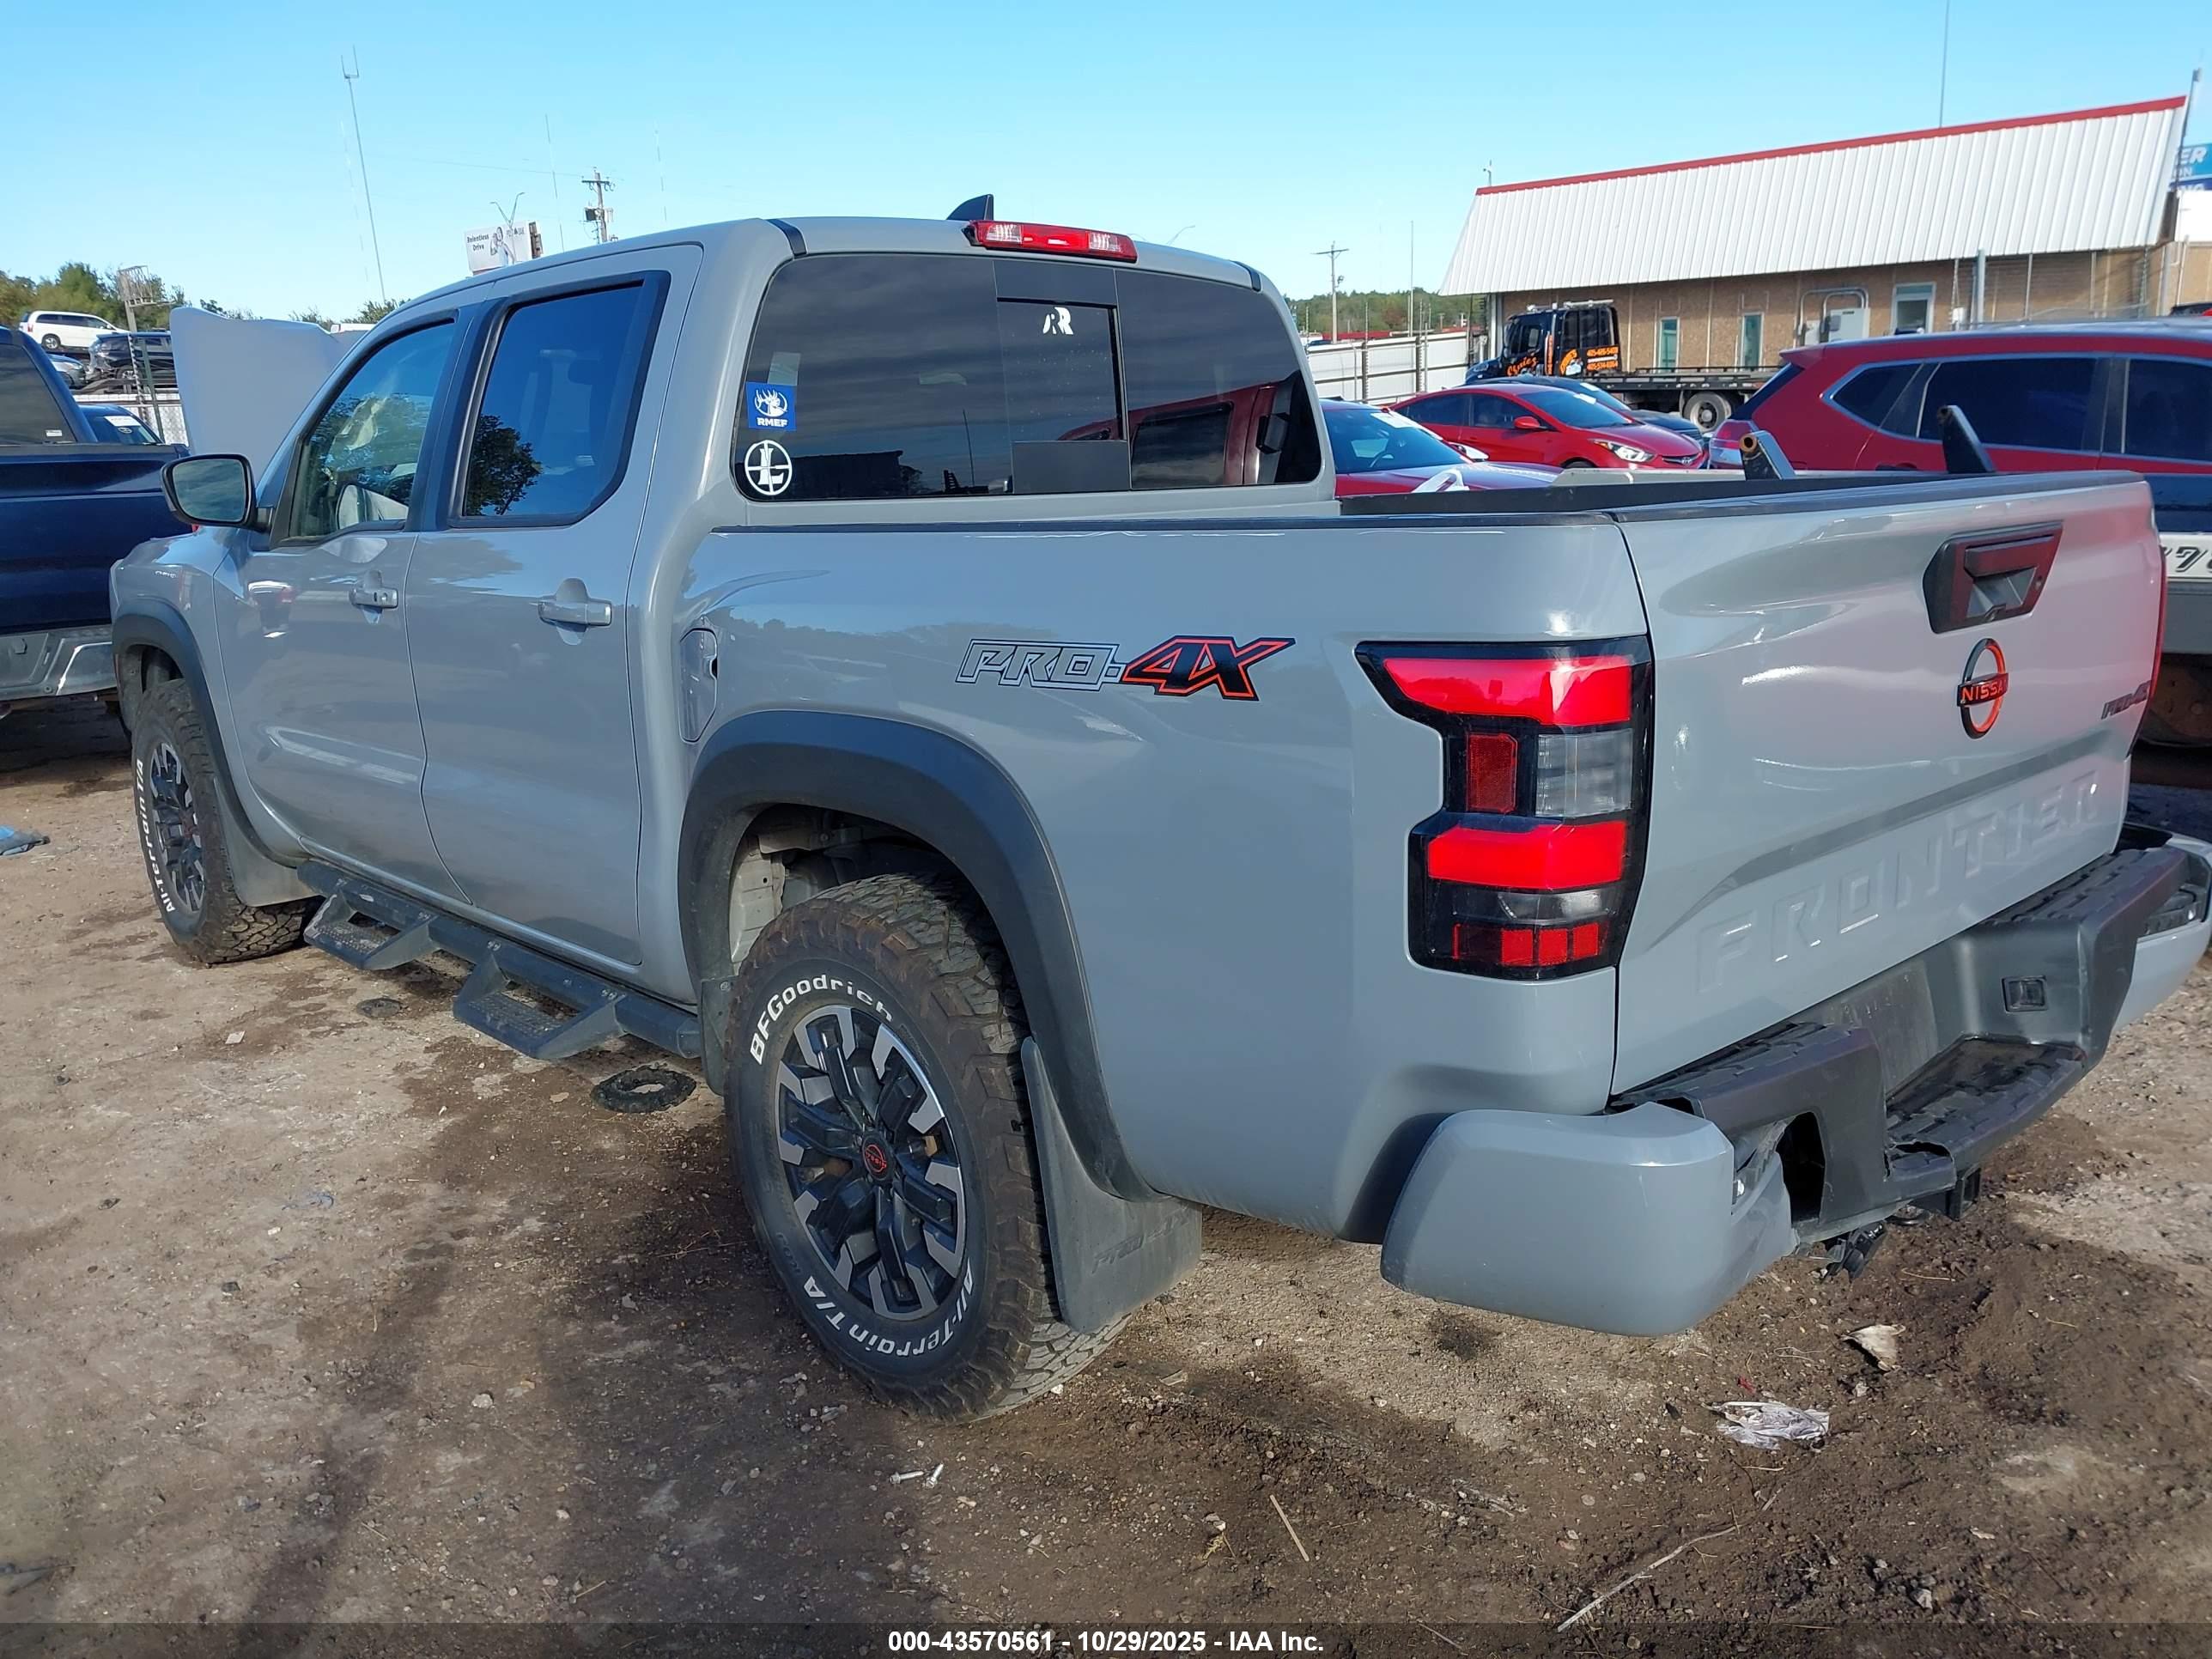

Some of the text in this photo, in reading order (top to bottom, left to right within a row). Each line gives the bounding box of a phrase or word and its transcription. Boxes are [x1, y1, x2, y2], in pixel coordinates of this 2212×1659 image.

[466, 234, 489, 243] Relentless
[756, 416, 788, 428] RMEF
[955, 635, 1296, 702] PRO-4X
[138, 796, 176, 913] All-Terrain
[1696, 769, 2098, 994] FRONTIER
[750, 974, 894, 1066] BFGoodrich
[803, 1257, 974, 1357] All-Terrain T/A
